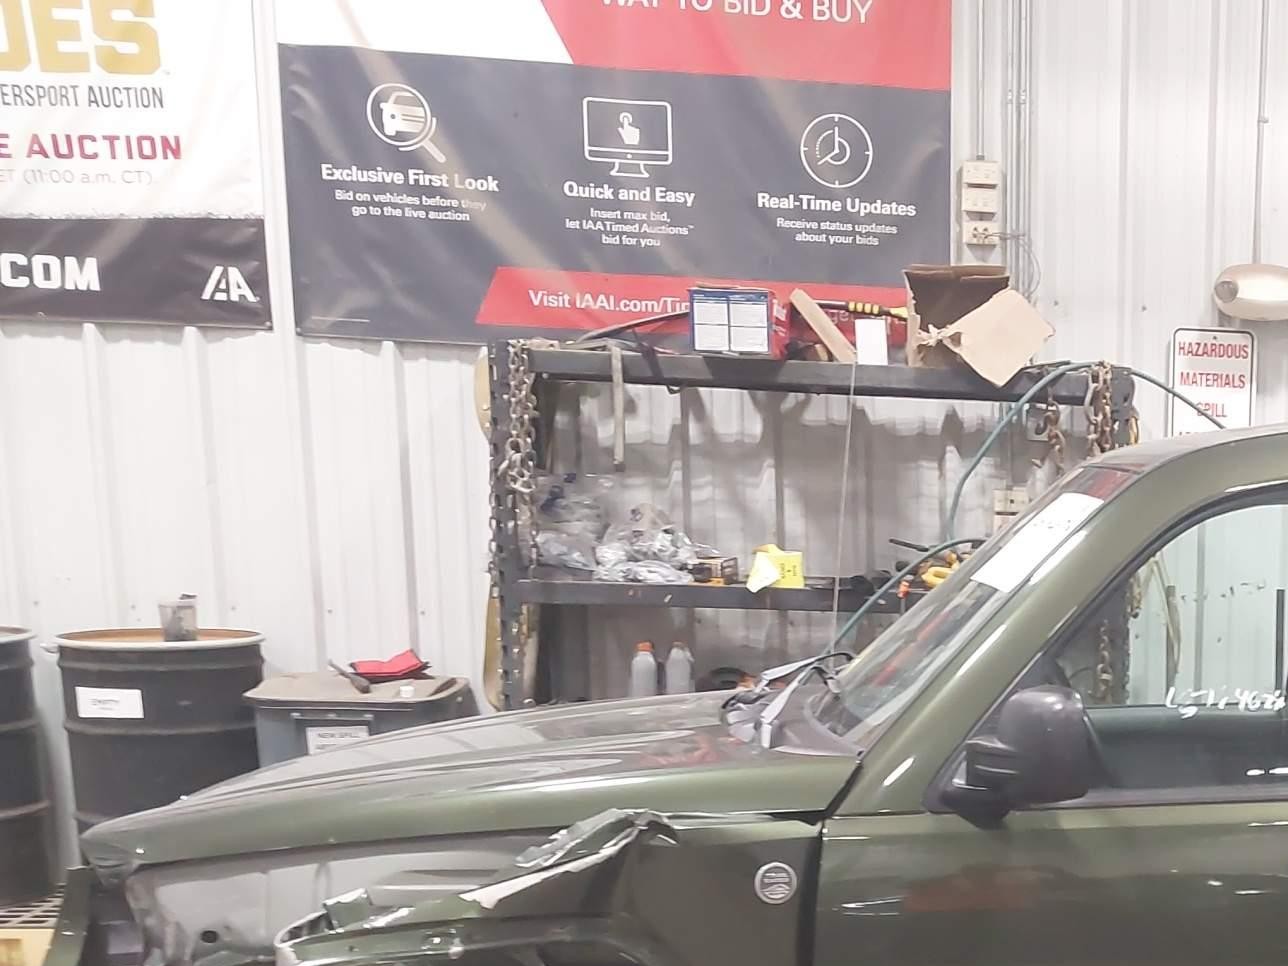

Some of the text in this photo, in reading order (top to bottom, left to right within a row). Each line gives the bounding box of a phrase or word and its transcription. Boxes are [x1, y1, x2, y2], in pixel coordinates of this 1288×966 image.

[724, 0, 771, 16] BID
[779, 0, 803, 19] &
[811, 0, 872, 23] BUY
[87, 85, 164, 109] AUCTION
[26, 133, 182, 160] AUCTION
[321, 163, 500, 192] Exclusive First Look
[335, 190, 487, 212] Bid on vehicles before they
[563, 181, 696, 207] Quick and Easy
[351, 206, 471, 221] go to the live auction
[757, 192, 917, 217] Real-Time Updates
[565, 219, 580, 229] let
[590, 208, 671, 223] Insert max bid,
[776, 218, 898, 234] Receive status updates
[602, 234, 661, 247] bid for you
[795, 231, 879, 246] about your bids
[528, 289, 570, 308] Visit
[1178, 341, 1249, 359] HAZARDOUS
[1179, 371, 1246, 389] MATERIALS
